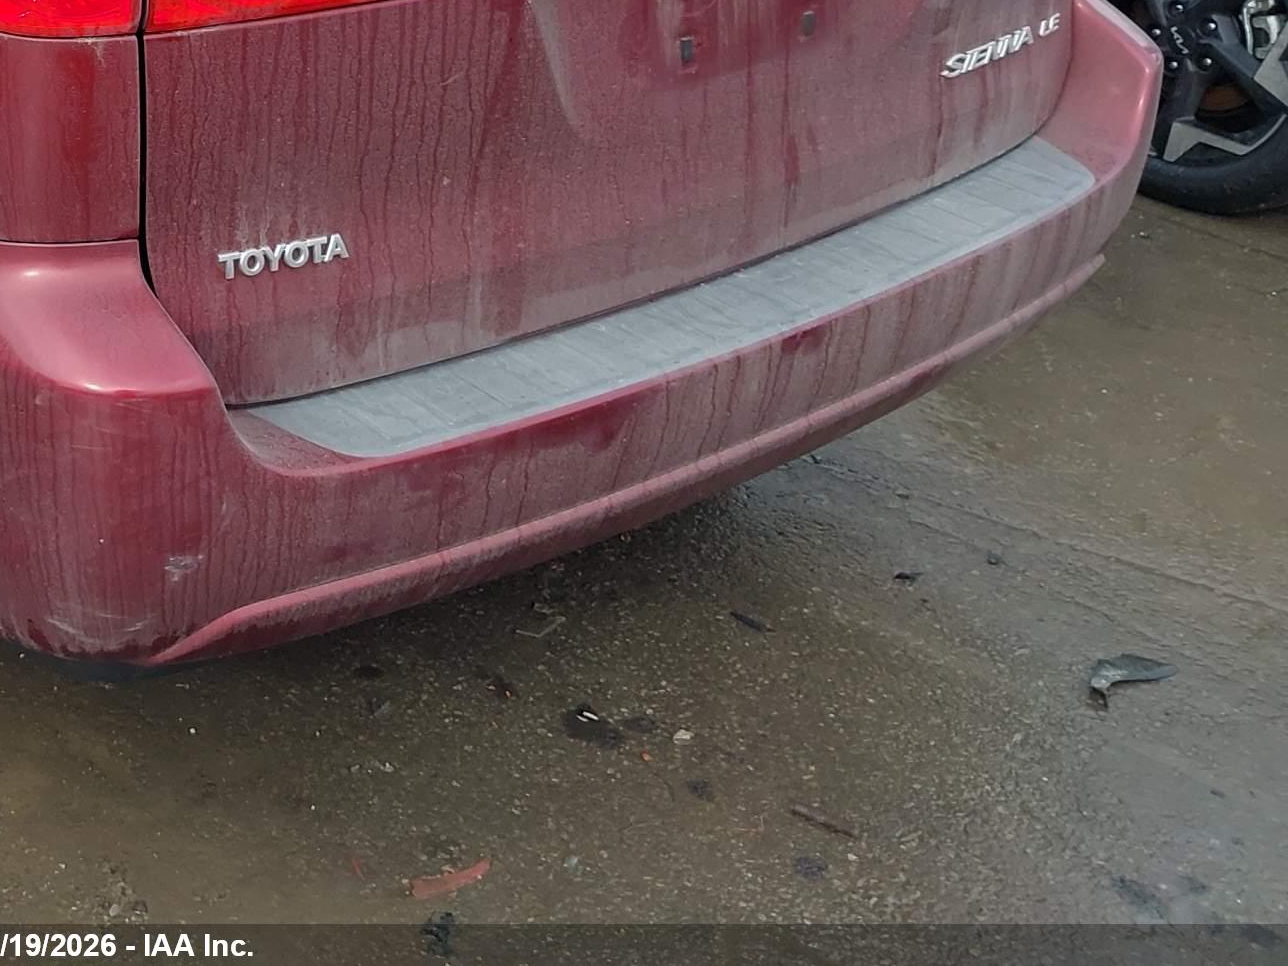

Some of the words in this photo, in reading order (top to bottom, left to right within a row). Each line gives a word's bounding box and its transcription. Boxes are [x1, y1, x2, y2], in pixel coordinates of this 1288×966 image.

[939, 25, 1034, 78] SIENNA
[1038, 12, 1061, 37] LE
[217, 232, 350, 280] TOYOTA
